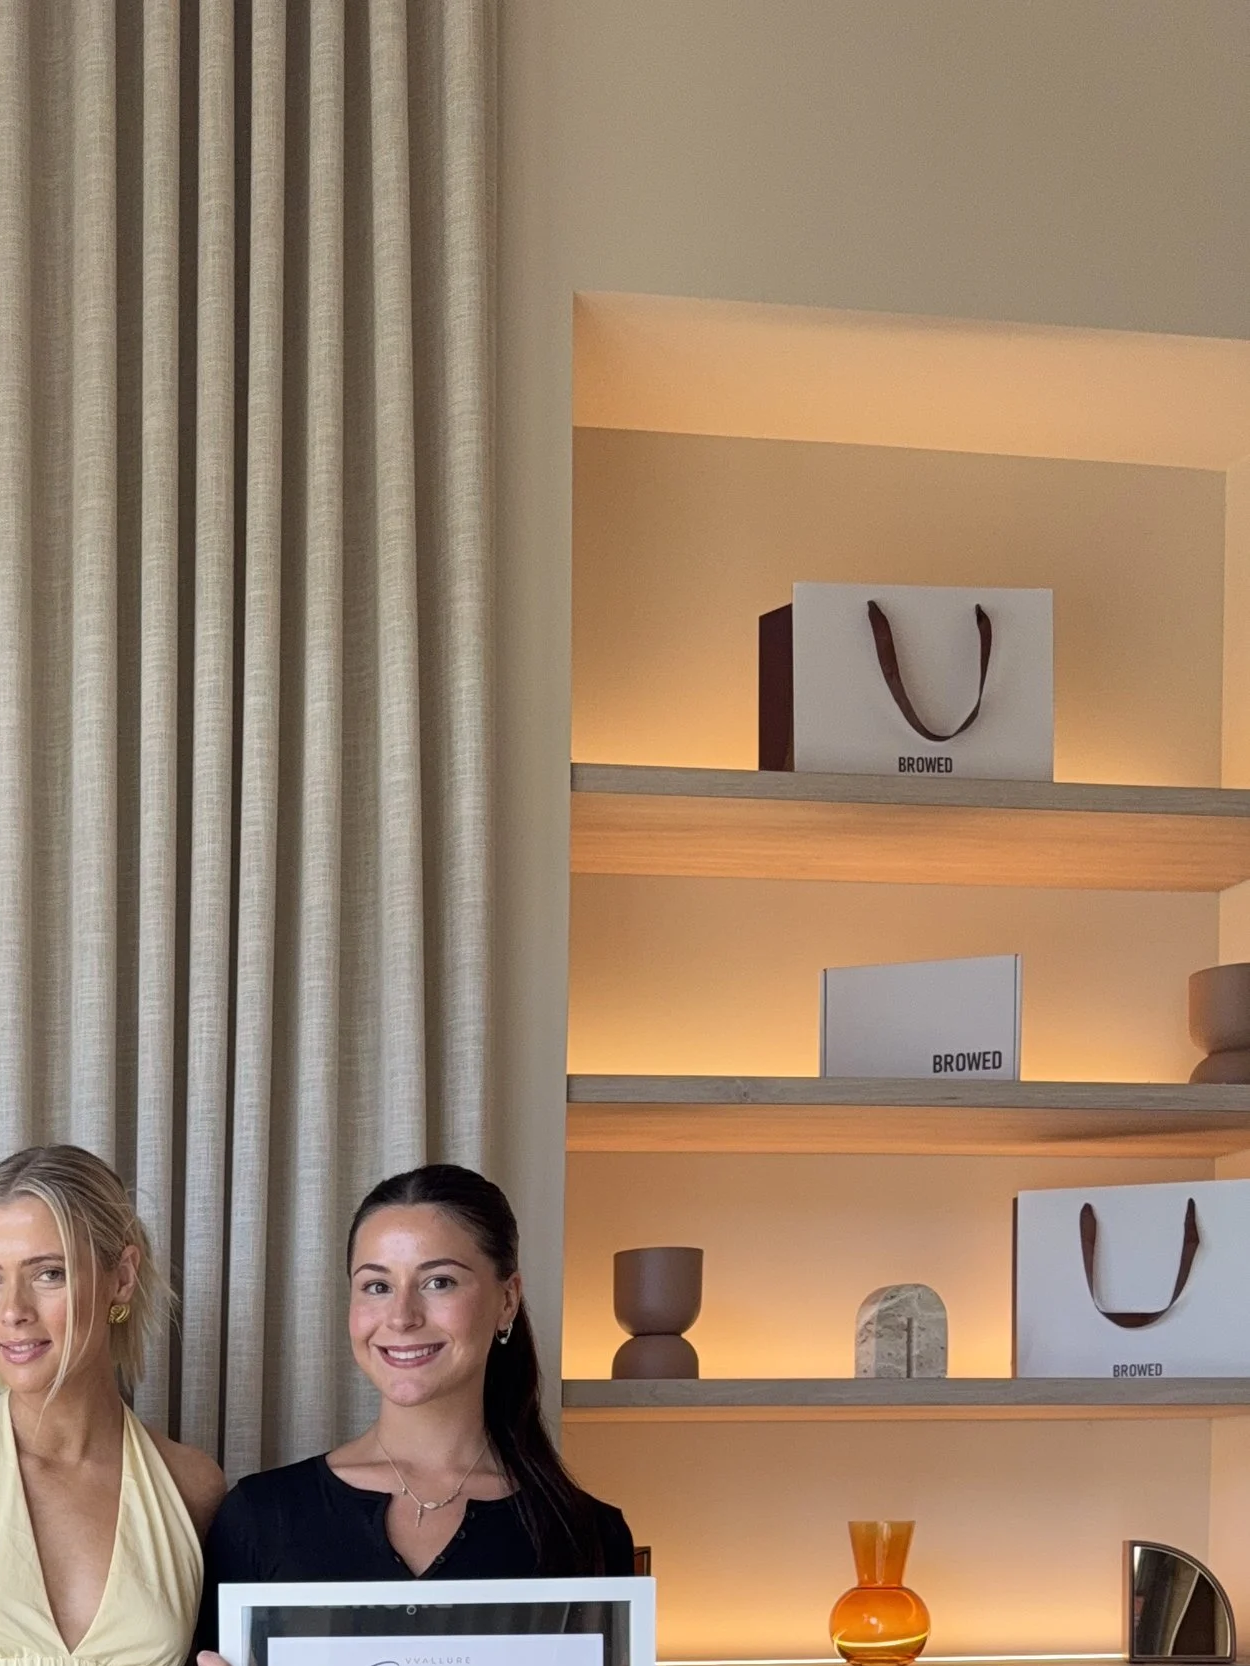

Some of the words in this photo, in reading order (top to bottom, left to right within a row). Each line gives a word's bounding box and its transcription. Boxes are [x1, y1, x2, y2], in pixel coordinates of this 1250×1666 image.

[898, 756, 953, 774] BROWED
[932, 1050, 1003, 1074] BROWED
[1112, 1363, 1163, 1378] BROWED
